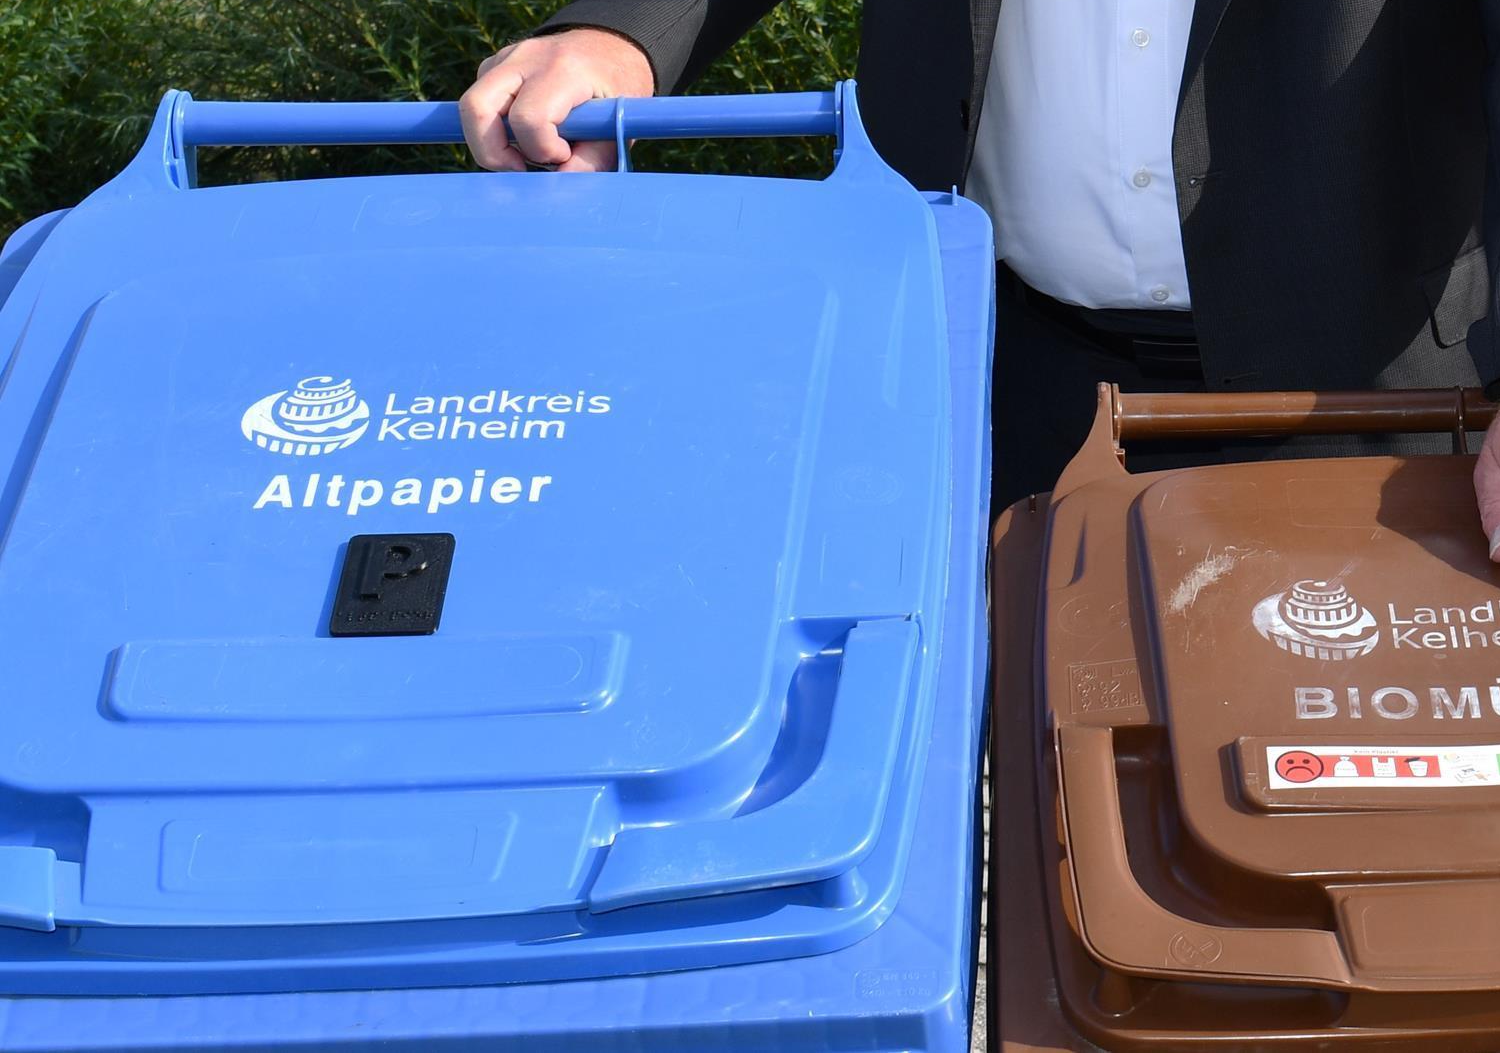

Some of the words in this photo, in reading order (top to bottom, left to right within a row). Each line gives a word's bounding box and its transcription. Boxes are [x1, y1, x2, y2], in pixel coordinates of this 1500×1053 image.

[384, 390, 611, 415] Landkreis
[378, 415, 566, 442] Kelheim
[253, 470, 552, 515] Altpapier
[360, 538, 427, 601] P
